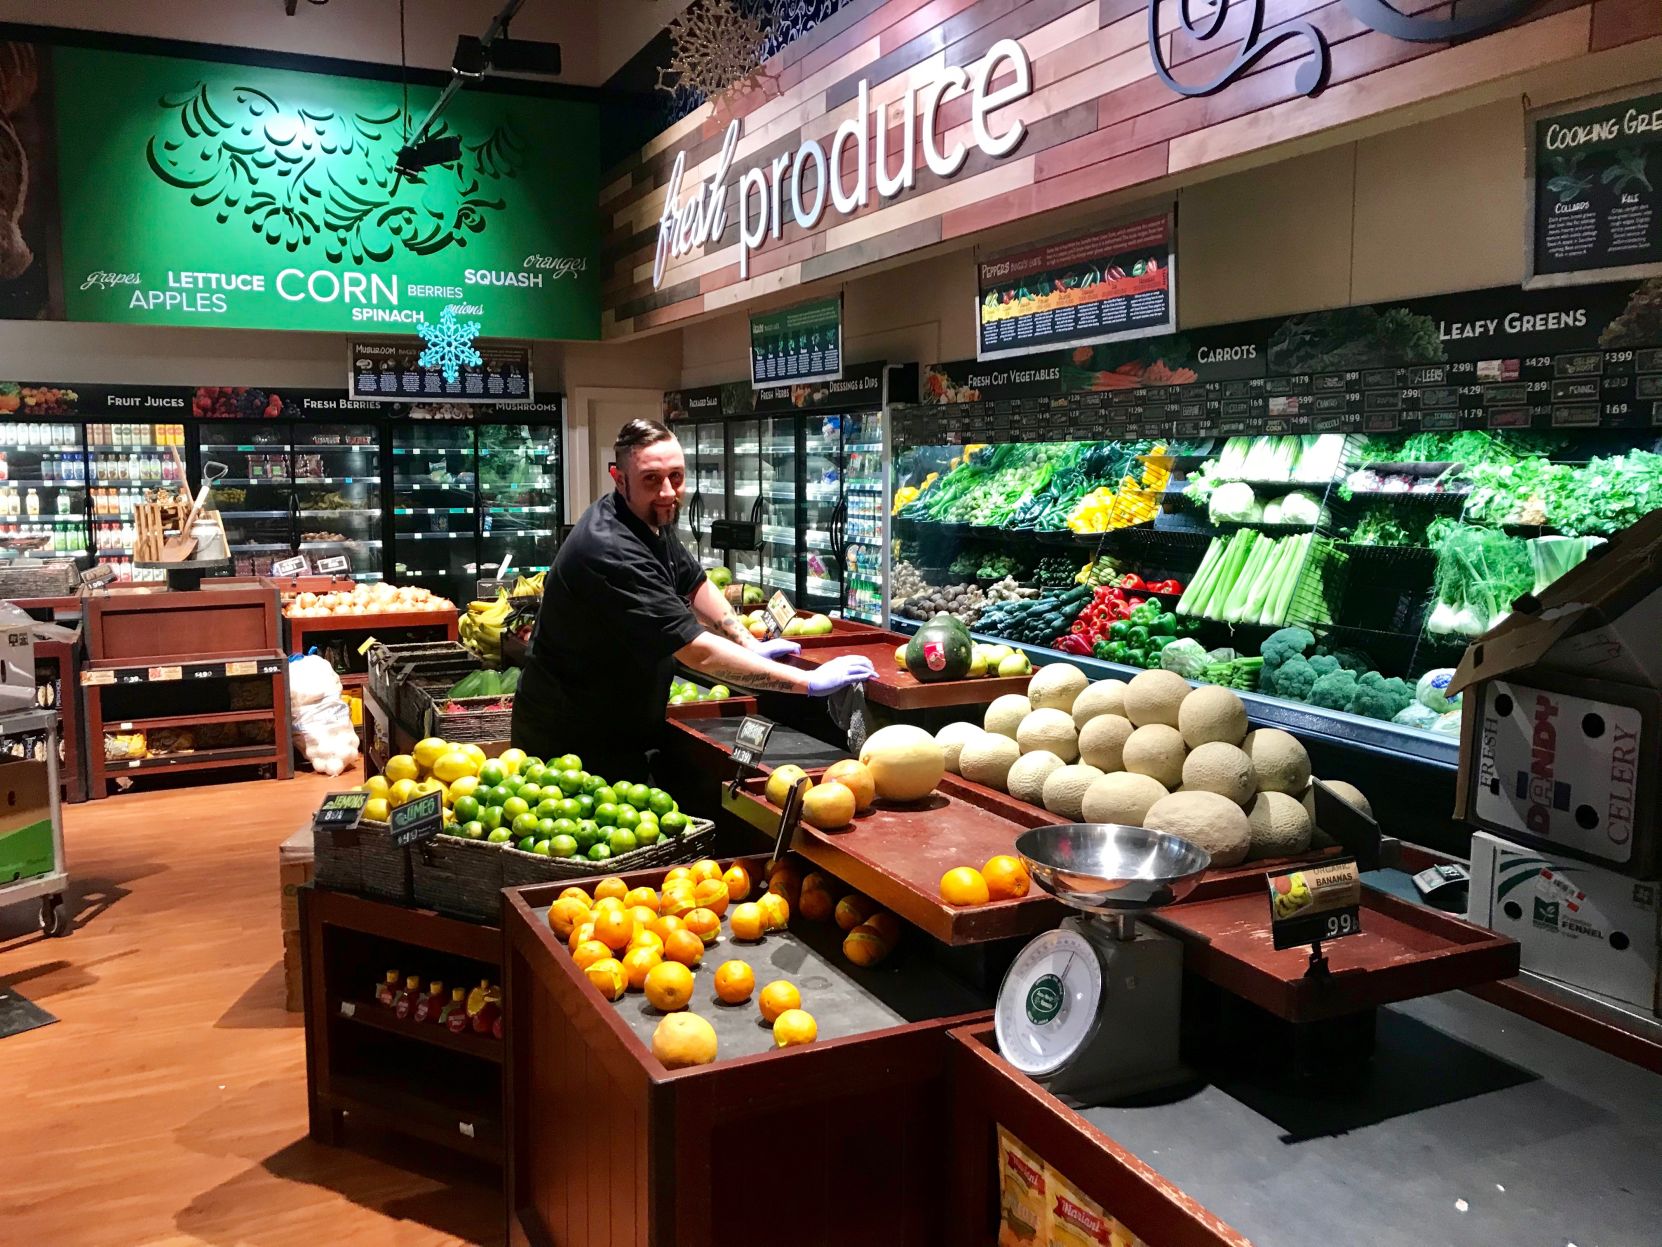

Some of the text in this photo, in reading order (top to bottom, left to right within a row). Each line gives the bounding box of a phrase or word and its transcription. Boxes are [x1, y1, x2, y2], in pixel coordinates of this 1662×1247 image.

[1546, 118, 1620, 150] COOKING
[653, 38, 1034, 291] fresh produce
[523, 253, 587, 279] oranges
[80, 270, 142, 290] grapes
[168, 271, 265, 291] LETTUCE
[276, 268, 398, 305] CORN
[464, 269, 543, 288] SQUASH
[407, 285, 463, 298] BERRIES
[129, 290, 228, 313] APPLES
[449, 301, 485, 315] nions
[352, 307, 424, 323] SPINACH
[1439, 309, 1587, 341] LEAFY GREENS
[1198, 345, 1256, 364] CARROTS
[829, 376, 878, 393] DRESSINGS & DIPS
[968, 367, 1060, 388] FRESH CUT VEGETABLES
[107, 395, 185, 408] FRUIT JUICES
[760, 388, 790, 400] FRESH HERBS
[303, 399, 381, 410] FRESH BERRIES
[496, 401, 557, 412] MUSHROOMS
[1480, 716, 1499, 789] FRESH
[1607, 723, 1638, 847] CELERY
[333, 793, 366, 809] LEMONS
[1316, 873, 1353, 887] BANANAS
[1562, 920, 1604, 939] FENNEL
